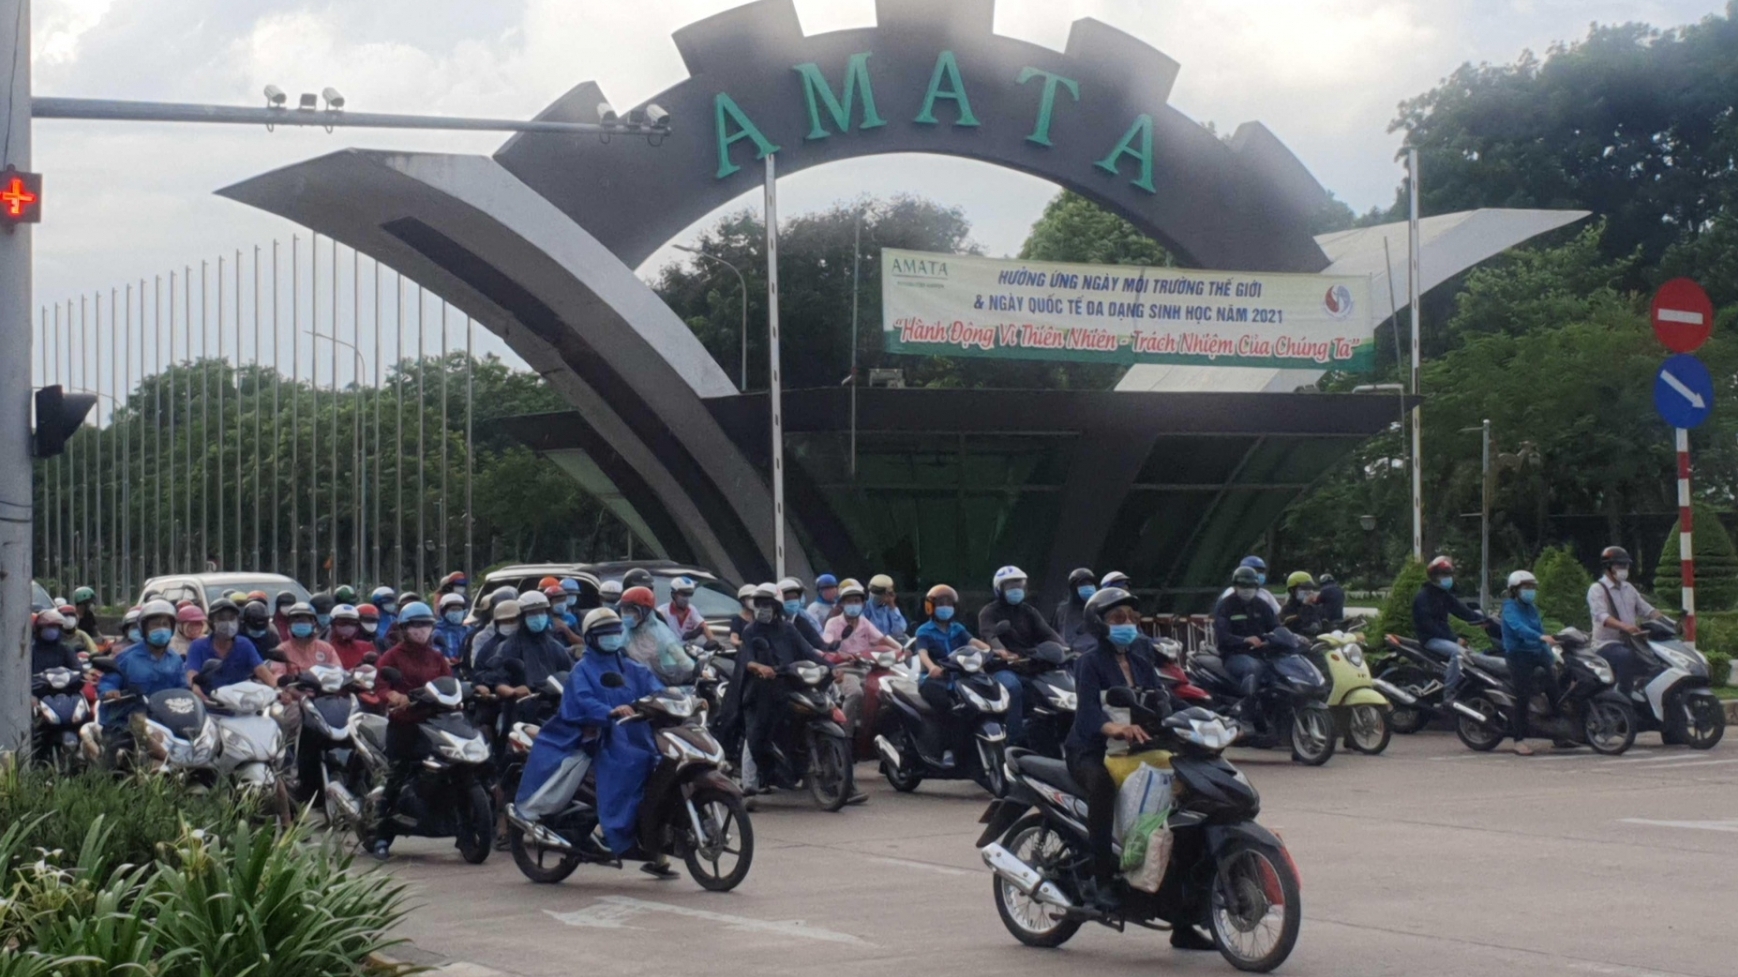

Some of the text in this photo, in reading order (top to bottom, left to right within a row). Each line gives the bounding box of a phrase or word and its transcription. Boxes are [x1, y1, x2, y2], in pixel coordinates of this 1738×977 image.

[714, 49, 1158, 193] AMATA
[891, 258, 949, 276] AMATA
[998, 266, 1262, 298] HƯỞNG ỨNG NGÀY MÔI TRƯỜNG THẾ GIỚI
[973, 293, 1283, 324] & NGÀY QUỐC TẾ ĐA DẠNG SINH HỌC NĂM 2021
[949, 320, 995, 348] Động
[1000, 323, 1016, 345] Vì
[1021, 323, 1063, 346] Thiên
[1068, 326, 1116, 349] Nhiên
[1132, 330, 1175, 352] Trách
[1179, 332, 1234, 358] Nhiệm
[1238, 334, 1270, 357] Của
[1274, 336, 1328, 361] Chúng
